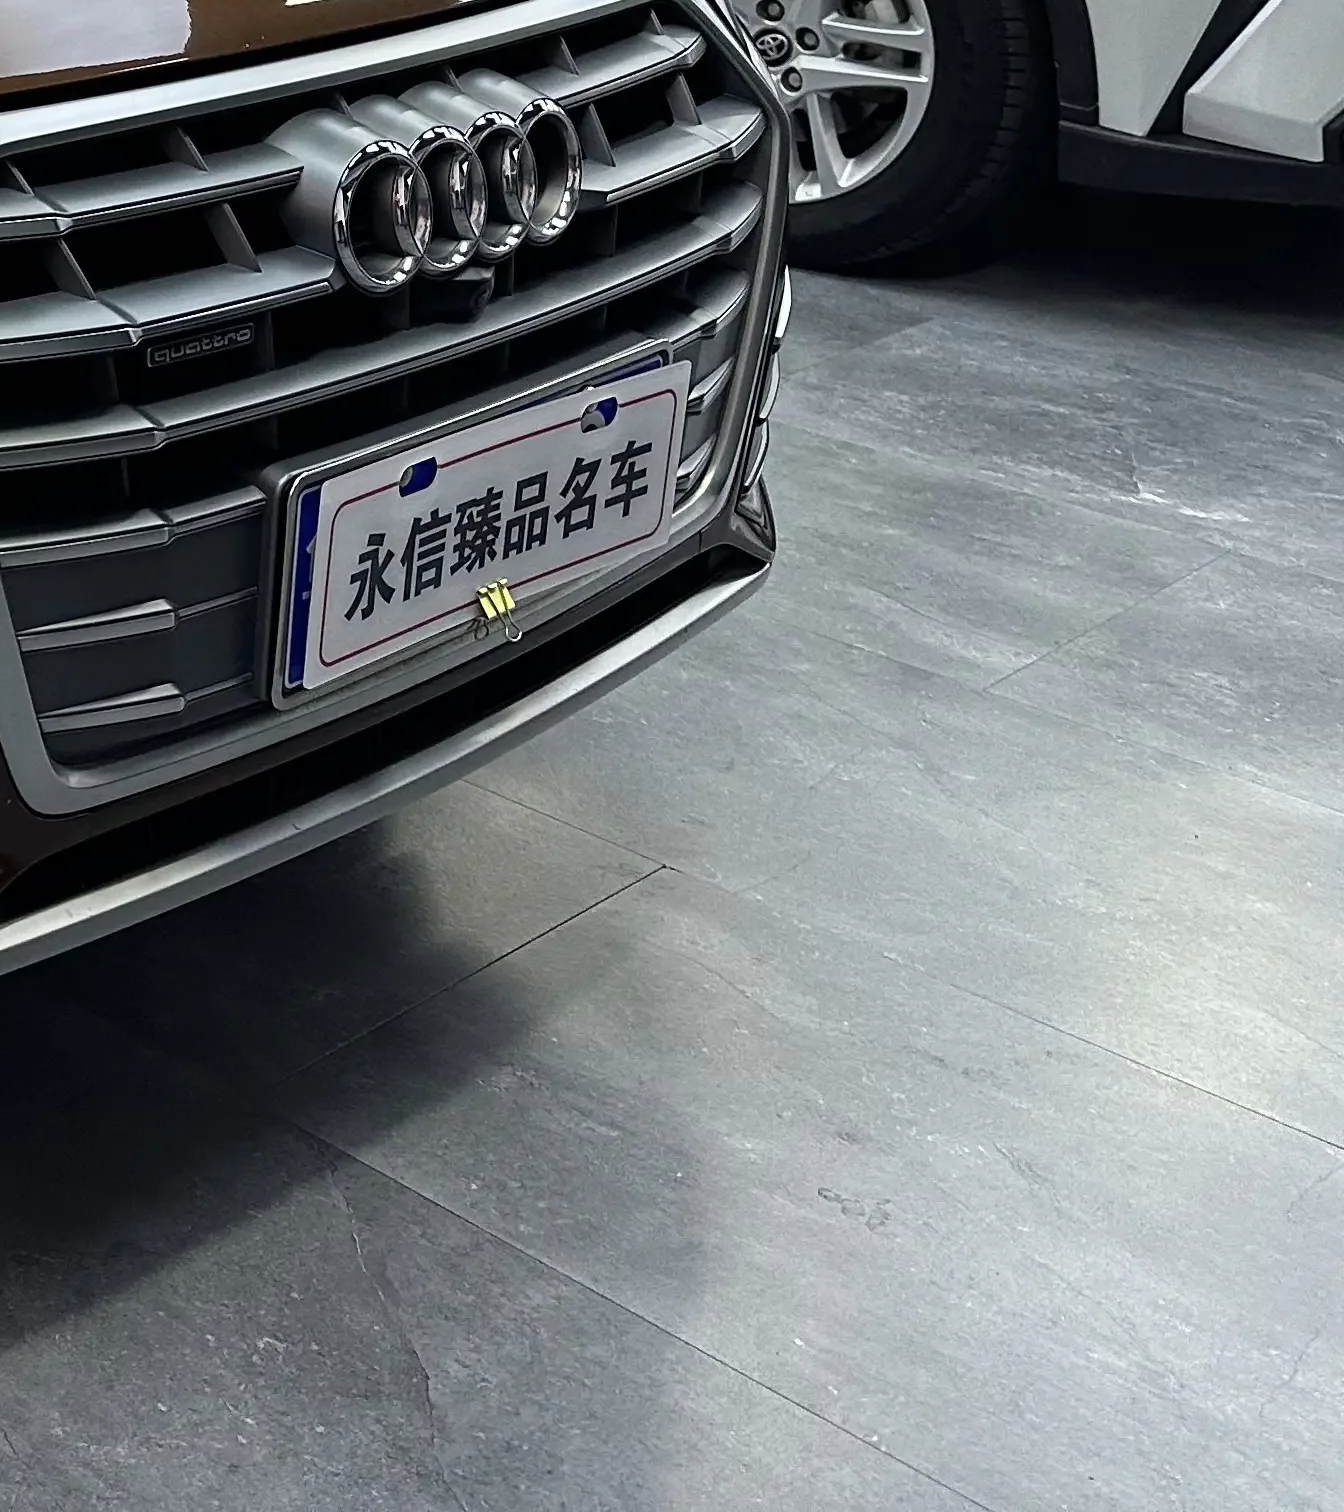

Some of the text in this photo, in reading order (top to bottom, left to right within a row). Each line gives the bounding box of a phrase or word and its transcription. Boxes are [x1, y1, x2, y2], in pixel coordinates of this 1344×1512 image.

[154, 328, 251, 363] quattro
[344, 439, 654, 622] 永信臻品名车
